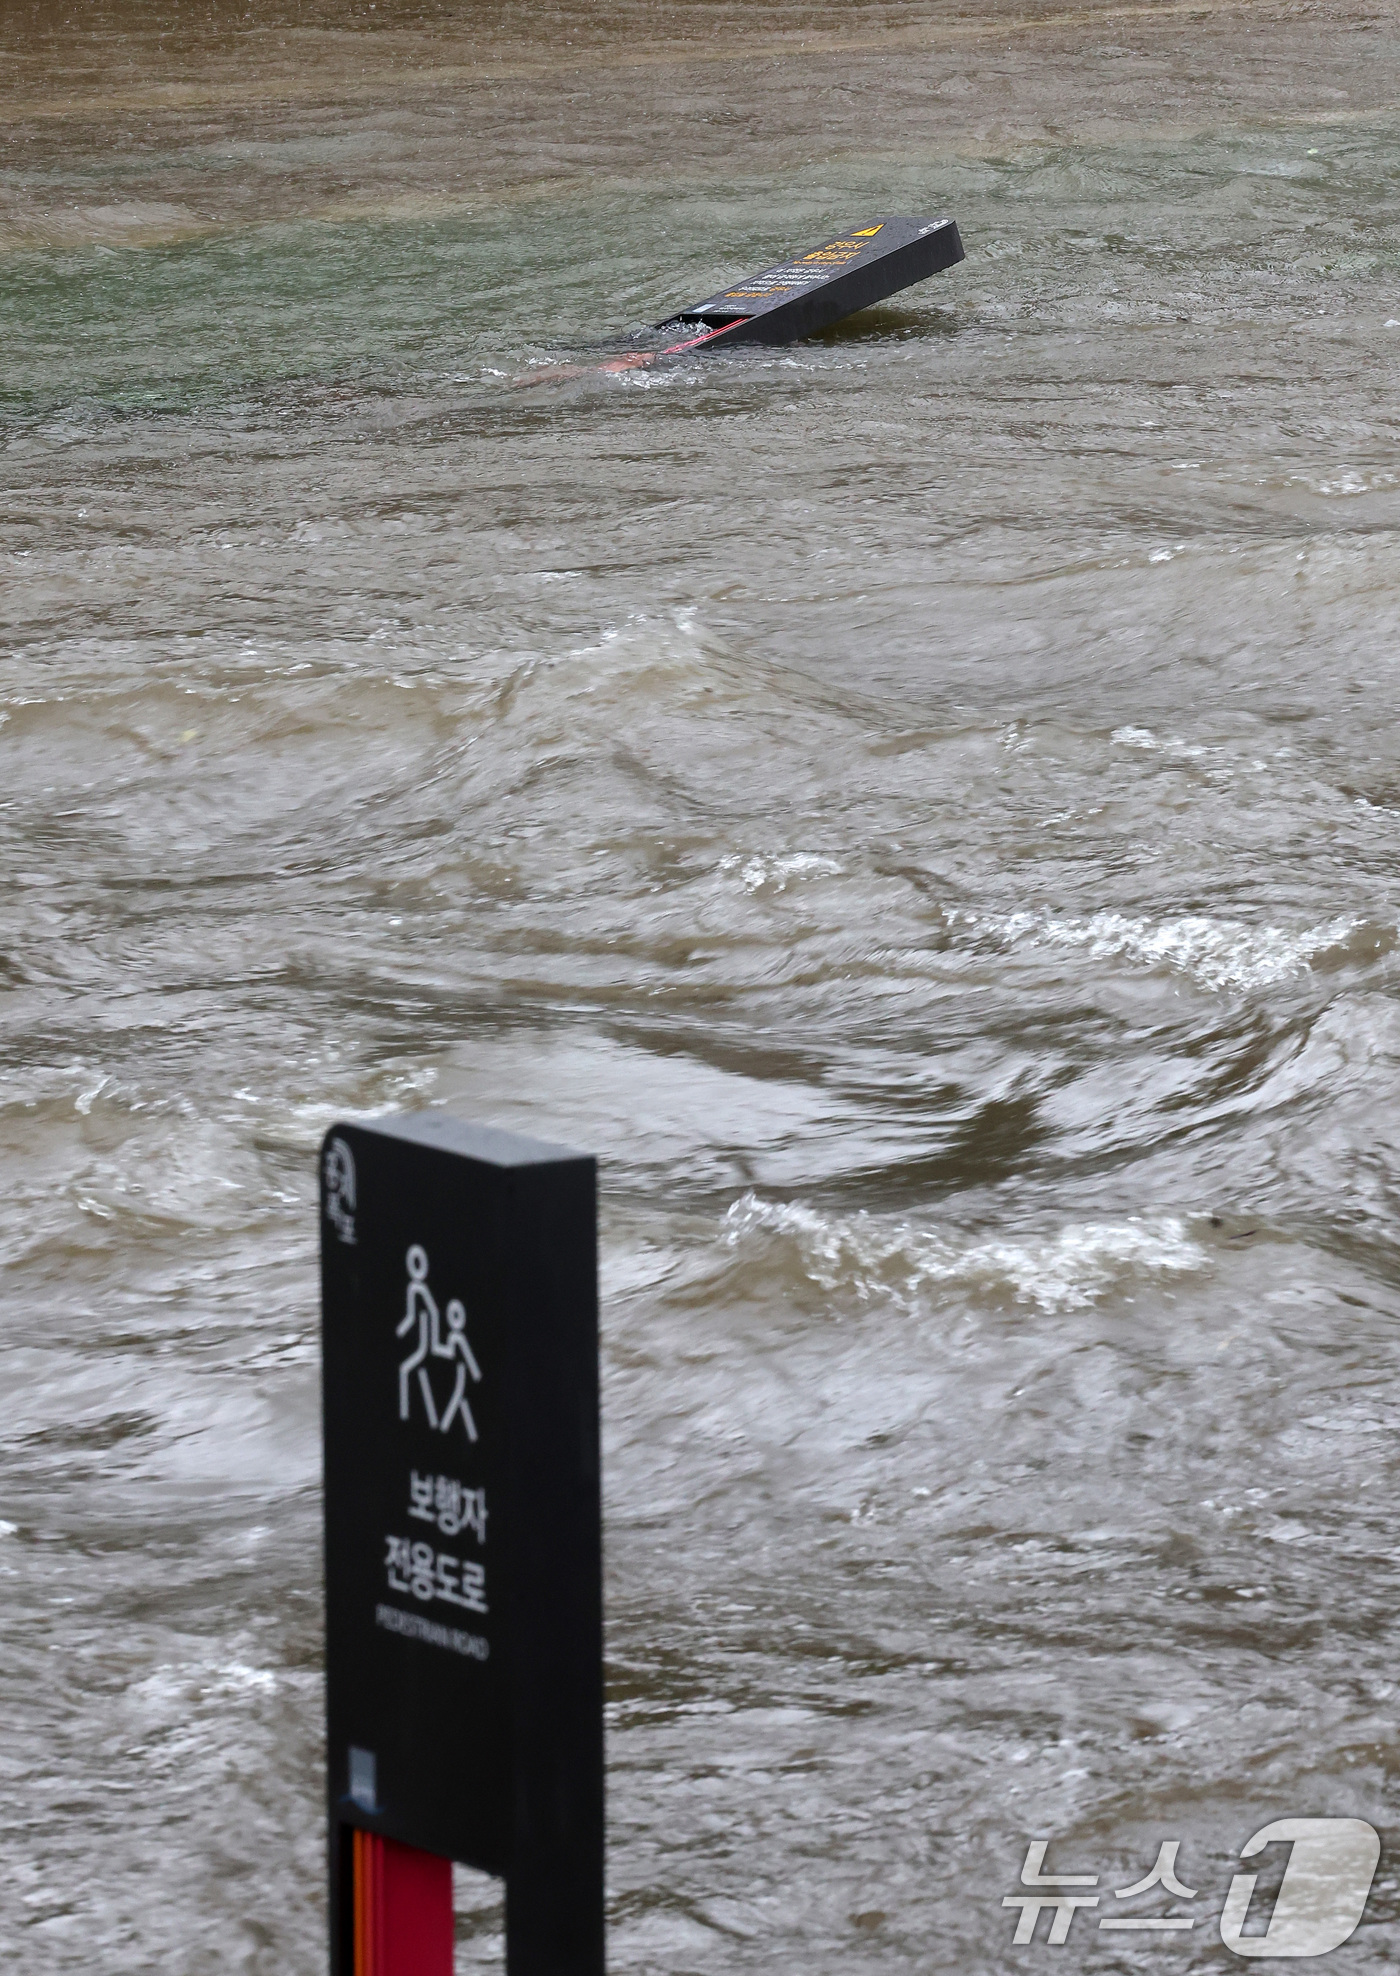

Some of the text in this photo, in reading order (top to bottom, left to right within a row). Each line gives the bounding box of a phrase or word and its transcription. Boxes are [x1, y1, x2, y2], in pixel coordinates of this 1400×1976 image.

[803, 251, 861, 260] 출입금지
[407, 1469, 489, 1544] 보행자
[384, 1535, 489, 1615] 전용도로
